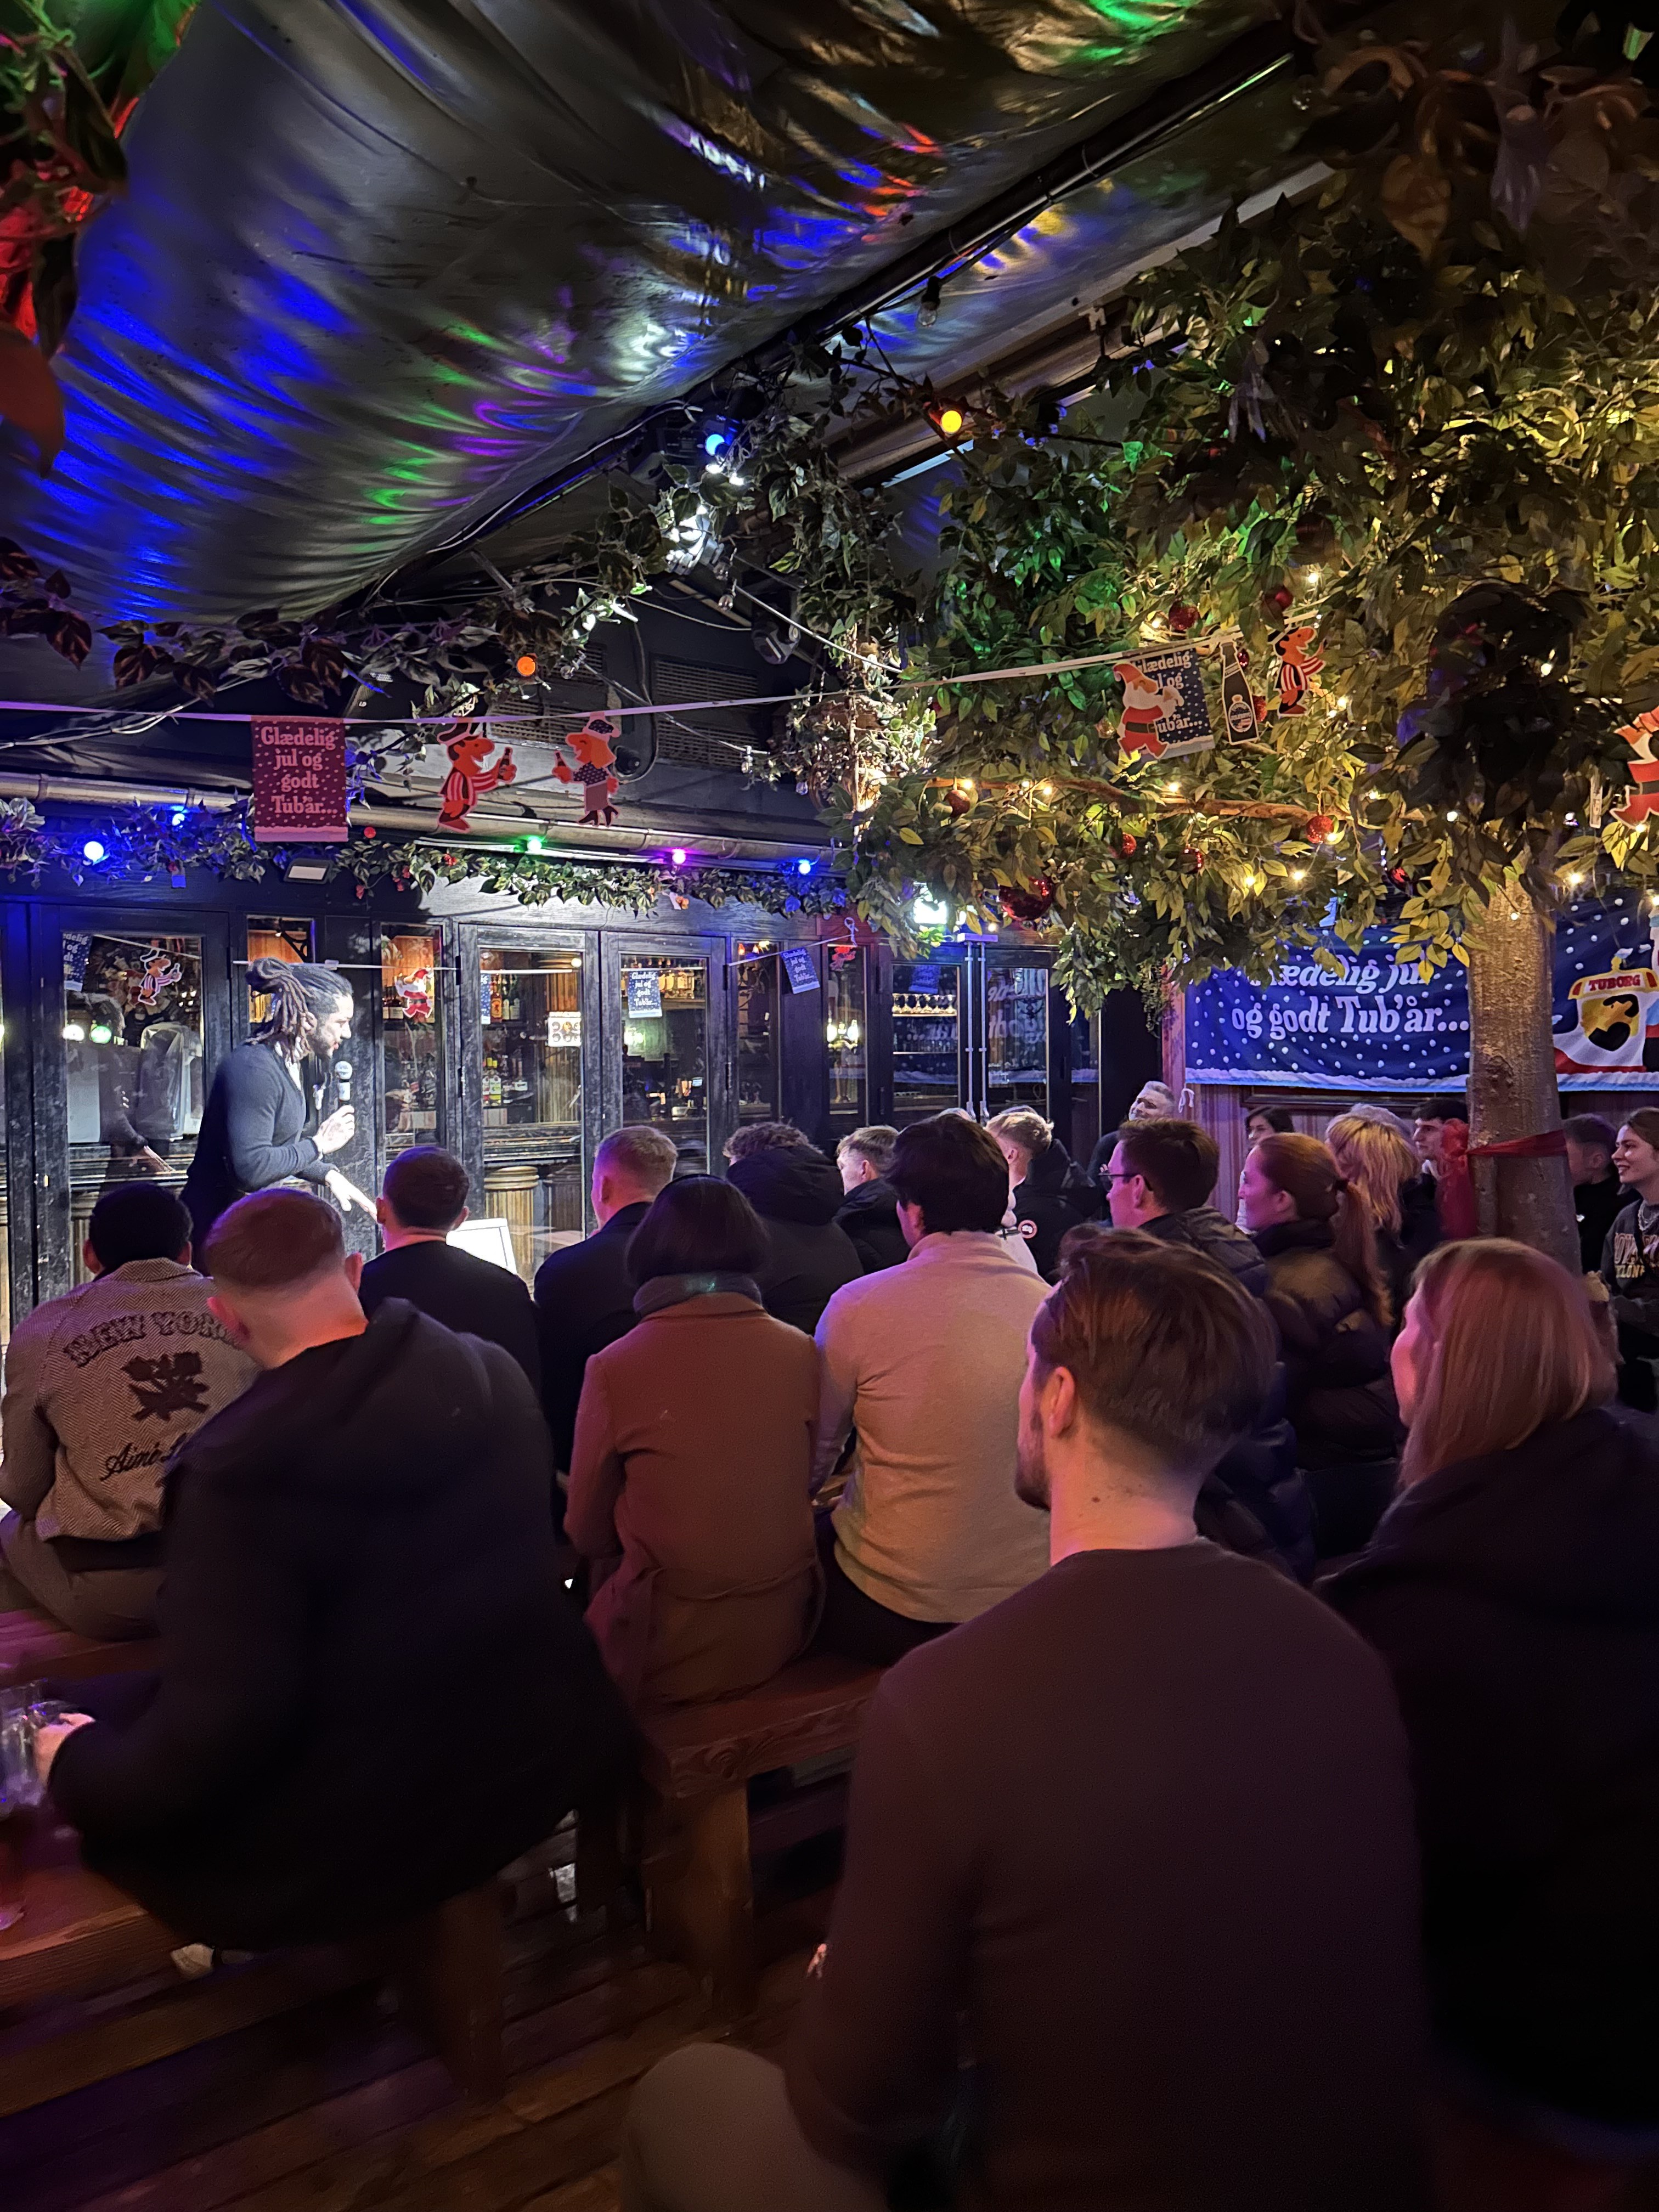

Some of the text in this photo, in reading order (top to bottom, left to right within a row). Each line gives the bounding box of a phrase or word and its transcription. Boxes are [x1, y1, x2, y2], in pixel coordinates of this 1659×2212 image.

[1166, 672, 1184, 690] og
[1158, 714, 1203, 733] ub'år...
[261, 726, 336, 751] Glædelig
[273, 748, 323, 770] jul og
[281, 770, 320, 792] godt
[1588, 974, 1641, 991] TUBORG
[1231, 1002, 1263, 1040] og
[1268, 995, 1331, 1040] godt
[63, 1315, 146, 1368] NEW
